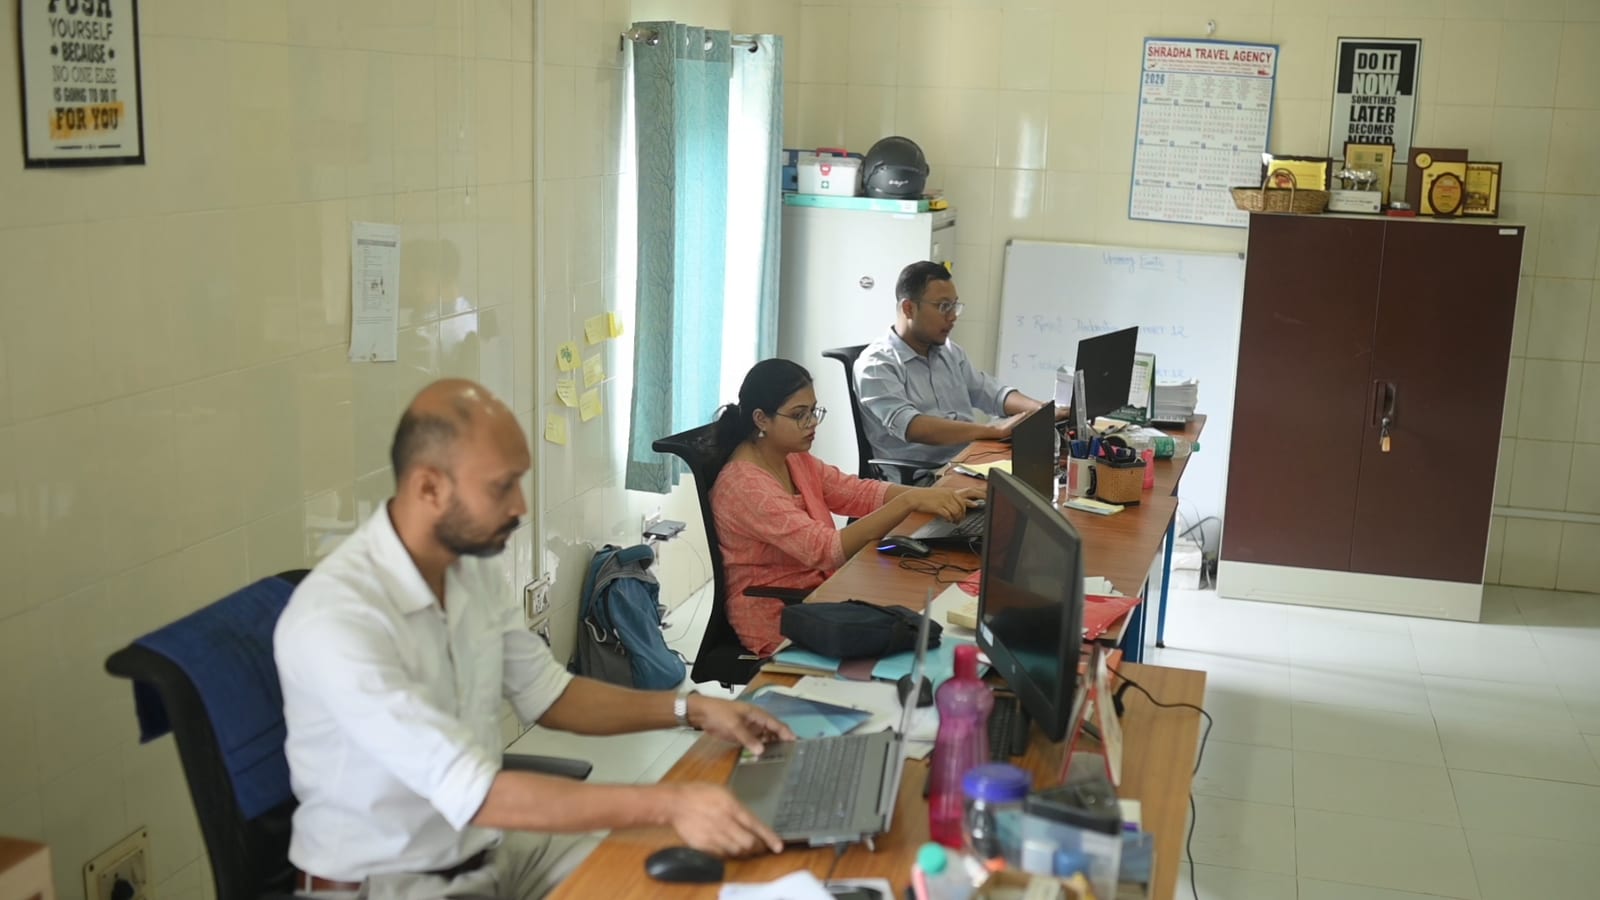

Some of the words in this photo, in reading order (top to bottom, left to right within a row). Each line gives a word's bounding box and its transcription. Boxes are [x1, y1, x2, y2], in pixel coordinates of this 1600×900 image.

[49, 17, 112, 41] YOURSELF
[62, 42, 106, 63] BECAUSE
[1148, 46, 1192, 58] SHRADHA
[1195, 48, 1229, 60] TRAVEL
[1233, 50, 1272, 63] AGENCY
[1357, 52, 1378, 70] DO
[1383, 53, 1397, 71] IT
[52, 65, 69, 82] NO
[71, 66, 93, 83] ONE
[95, 67, 116, 83] ELSE
[1351, 95, 1397, 105] SOMETIMES
[56, 107, 87, 130] FOR
[91, 107, 118, 130] YOU
[1350, 105, 1396, 123] LATER
[1348, 123, 1394, 135] BECOMES
